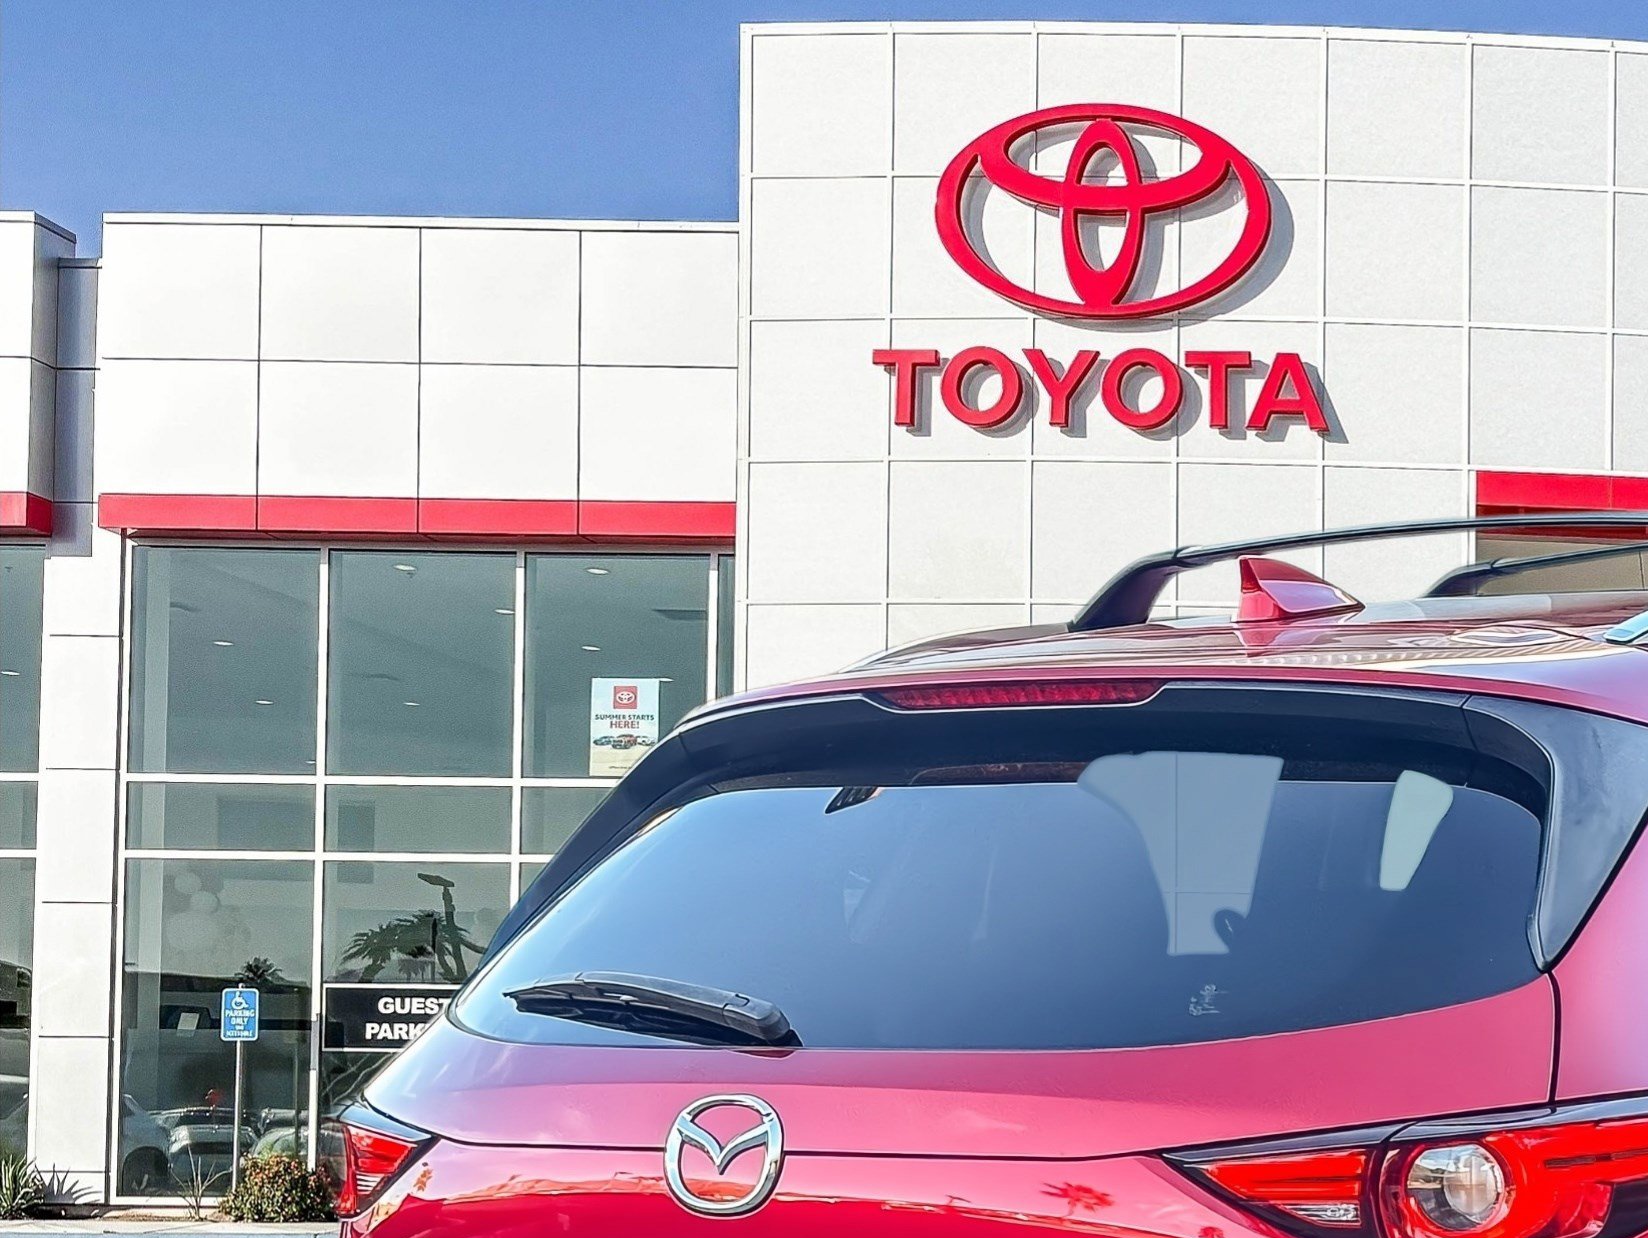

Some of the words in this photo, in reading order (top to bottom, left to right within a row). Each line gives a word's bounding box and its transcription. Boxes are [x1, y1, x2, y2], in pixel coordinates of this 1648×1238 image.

[872, 345, 1330, 432] TOYOTA
[609, 721, 640, 729] HERE!
[377, 997, 452, 1015] GUEST
[364, 1022, 426, 1040] PARK
